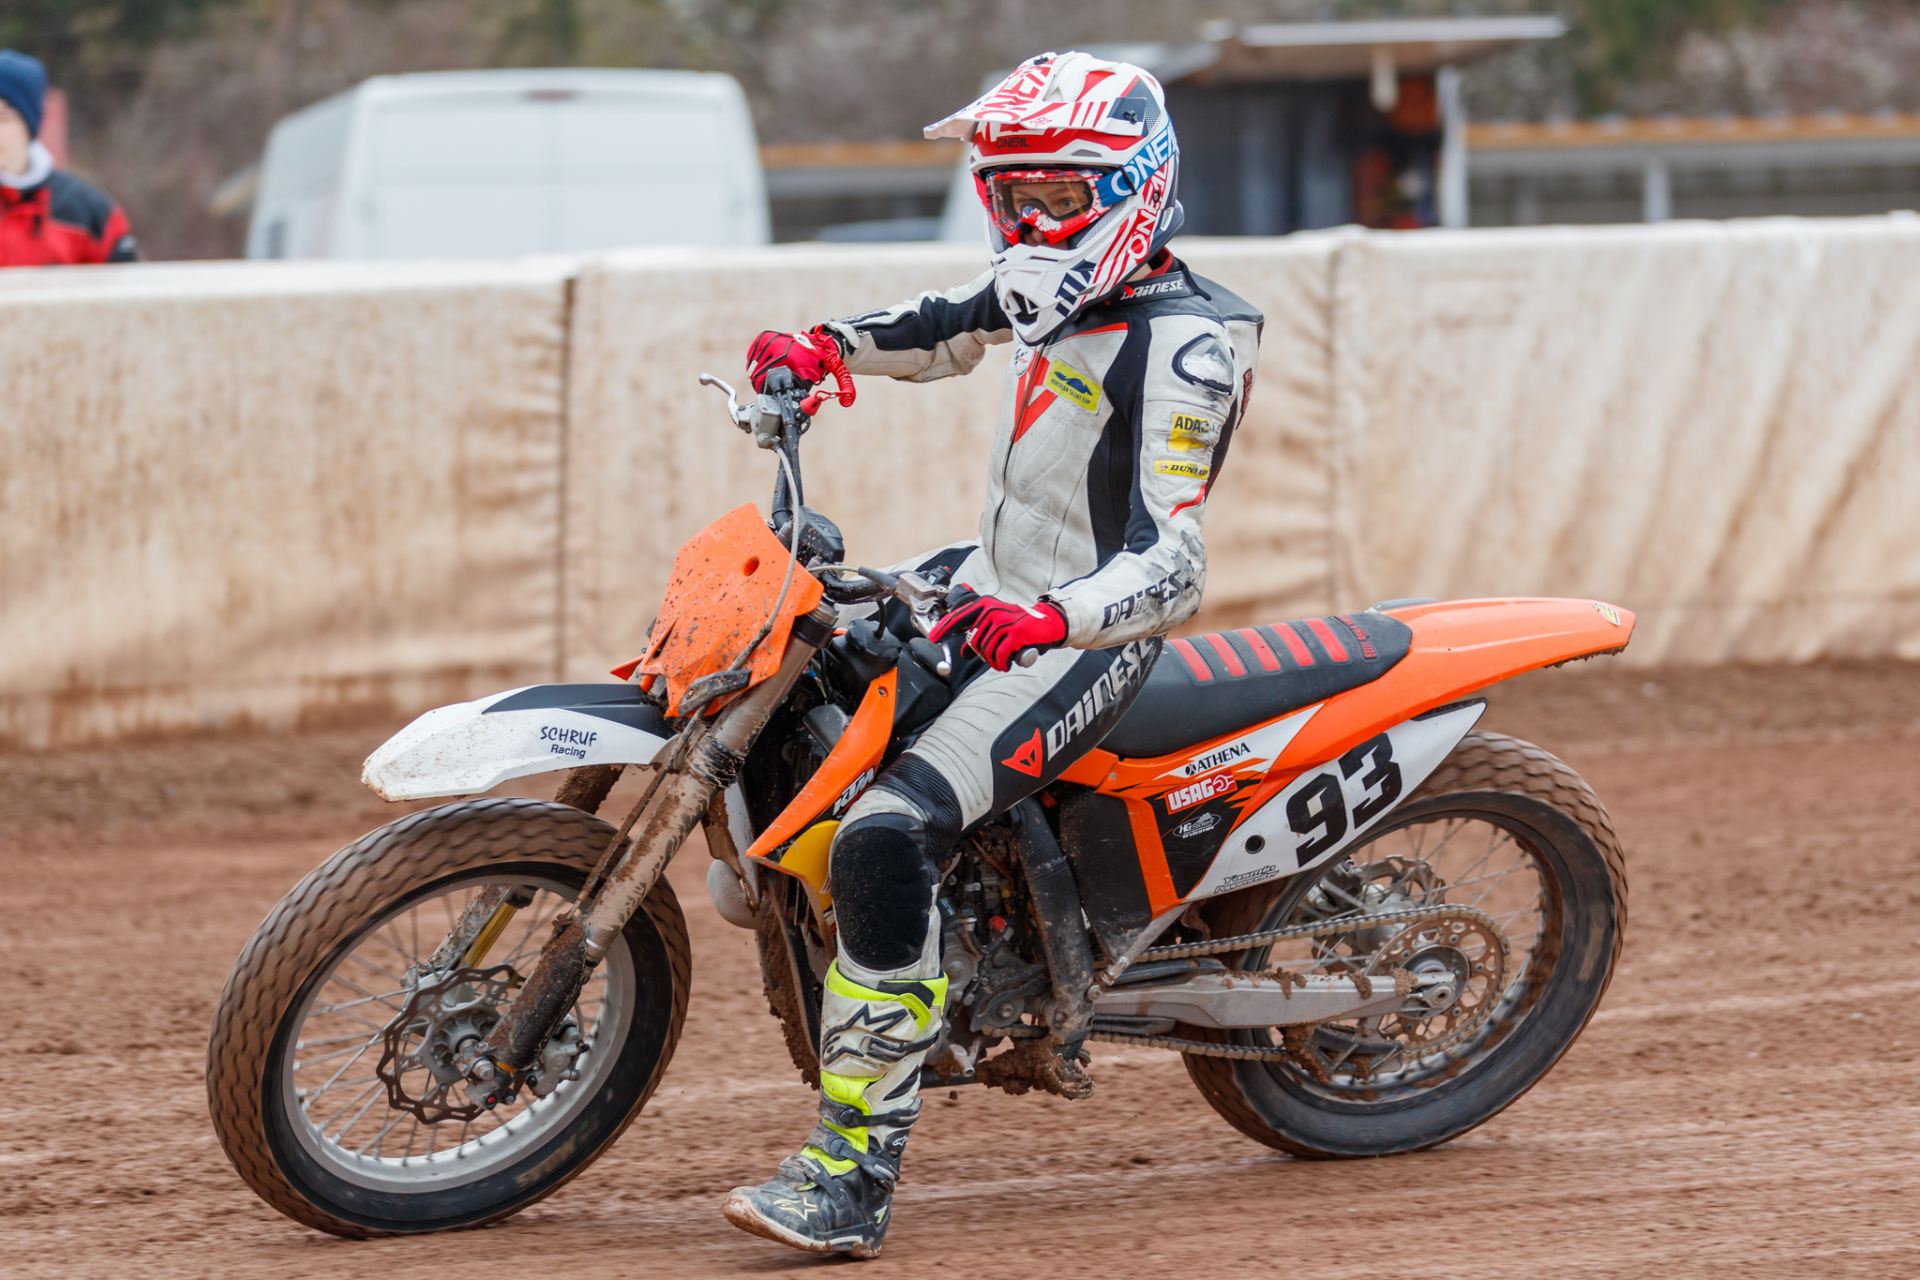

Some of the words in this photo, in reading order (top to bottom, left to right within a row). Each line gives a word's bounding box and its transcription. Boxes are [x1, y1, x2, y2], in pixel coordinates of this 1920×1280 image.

[540, 726, 597, 747] SCHRUF
[550, 743, 586, 760] Racing
[1197, 742, 1251, 773] ATHENA
[1167, 777, 1215, 811] USAG
[1286, 732, 1403, 869] 93
